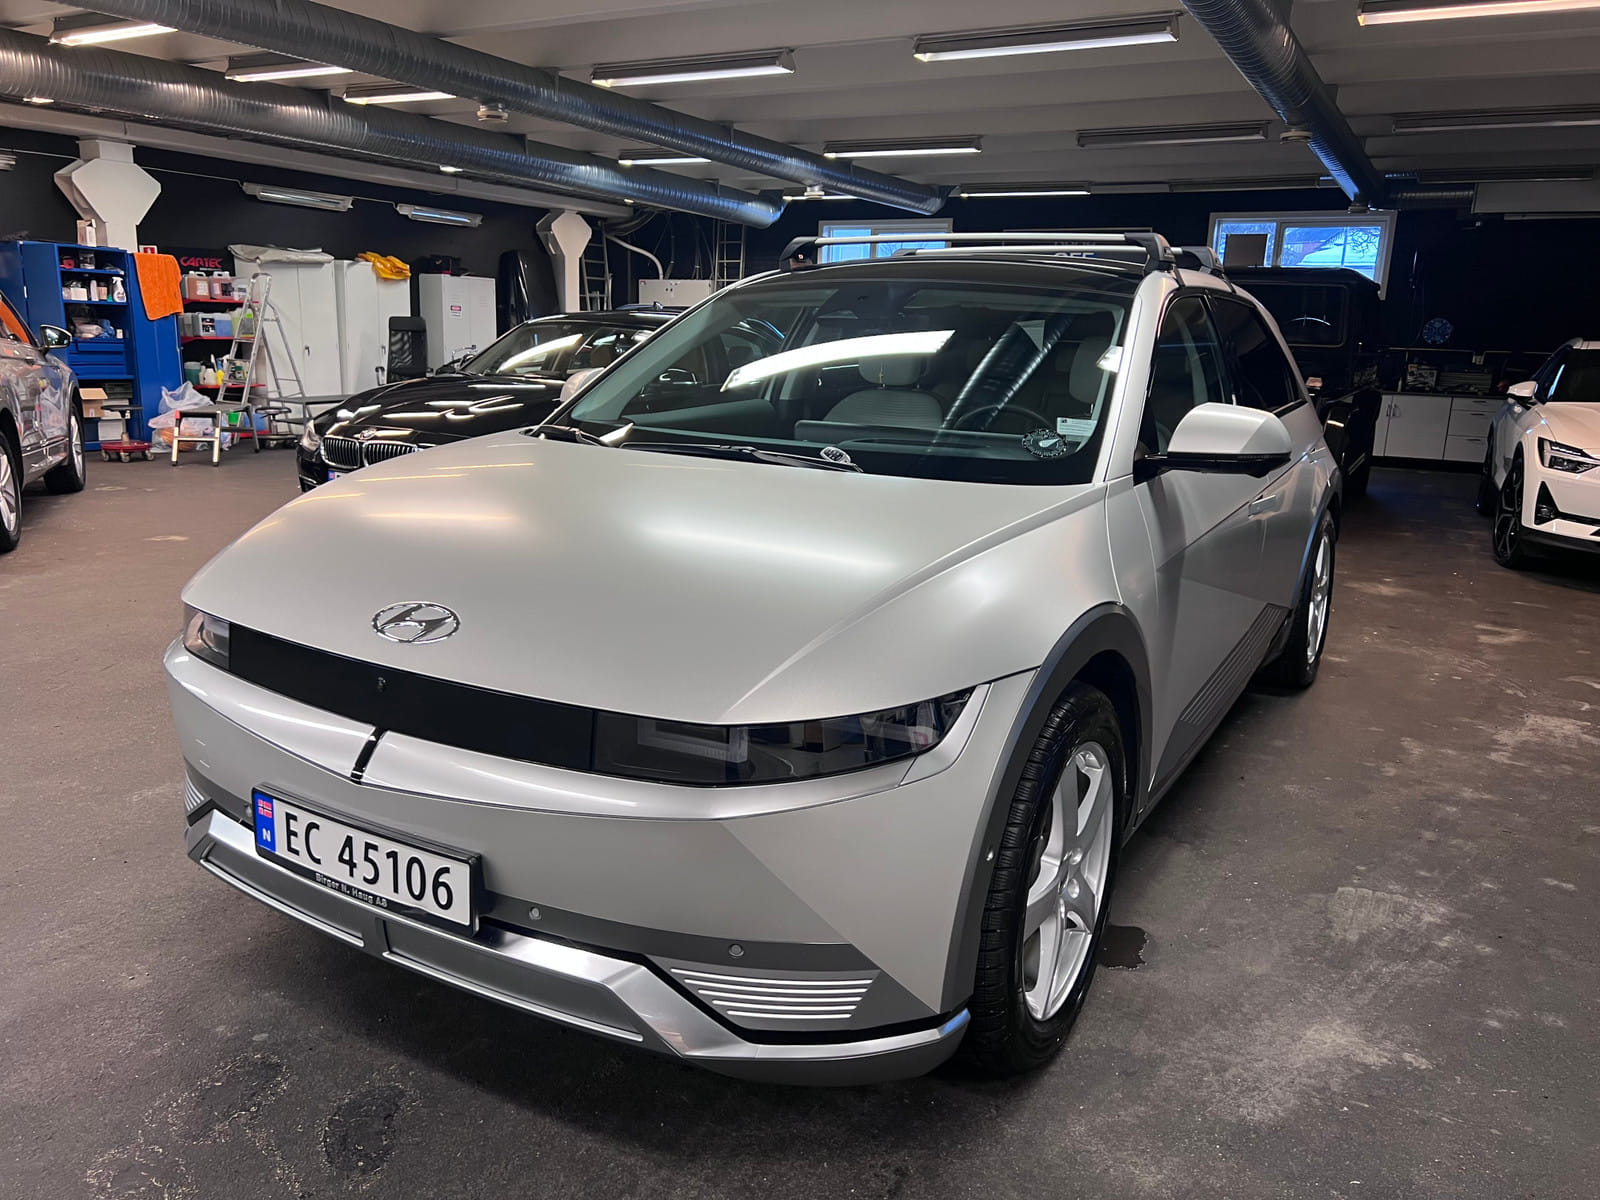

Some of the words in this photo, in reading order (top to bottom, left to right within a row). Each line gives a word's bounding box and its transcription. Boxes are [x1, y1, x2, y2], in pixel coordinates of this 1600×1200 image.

[180, 256, 223, 268] CARTEC
[262, 827, 271, 842] N
[284, 811, 322, 865] EC
[337, 834, 454, 911] 45106
[315, 872, 340, 889] Birger
[352, 887, 374, 904] Haug
